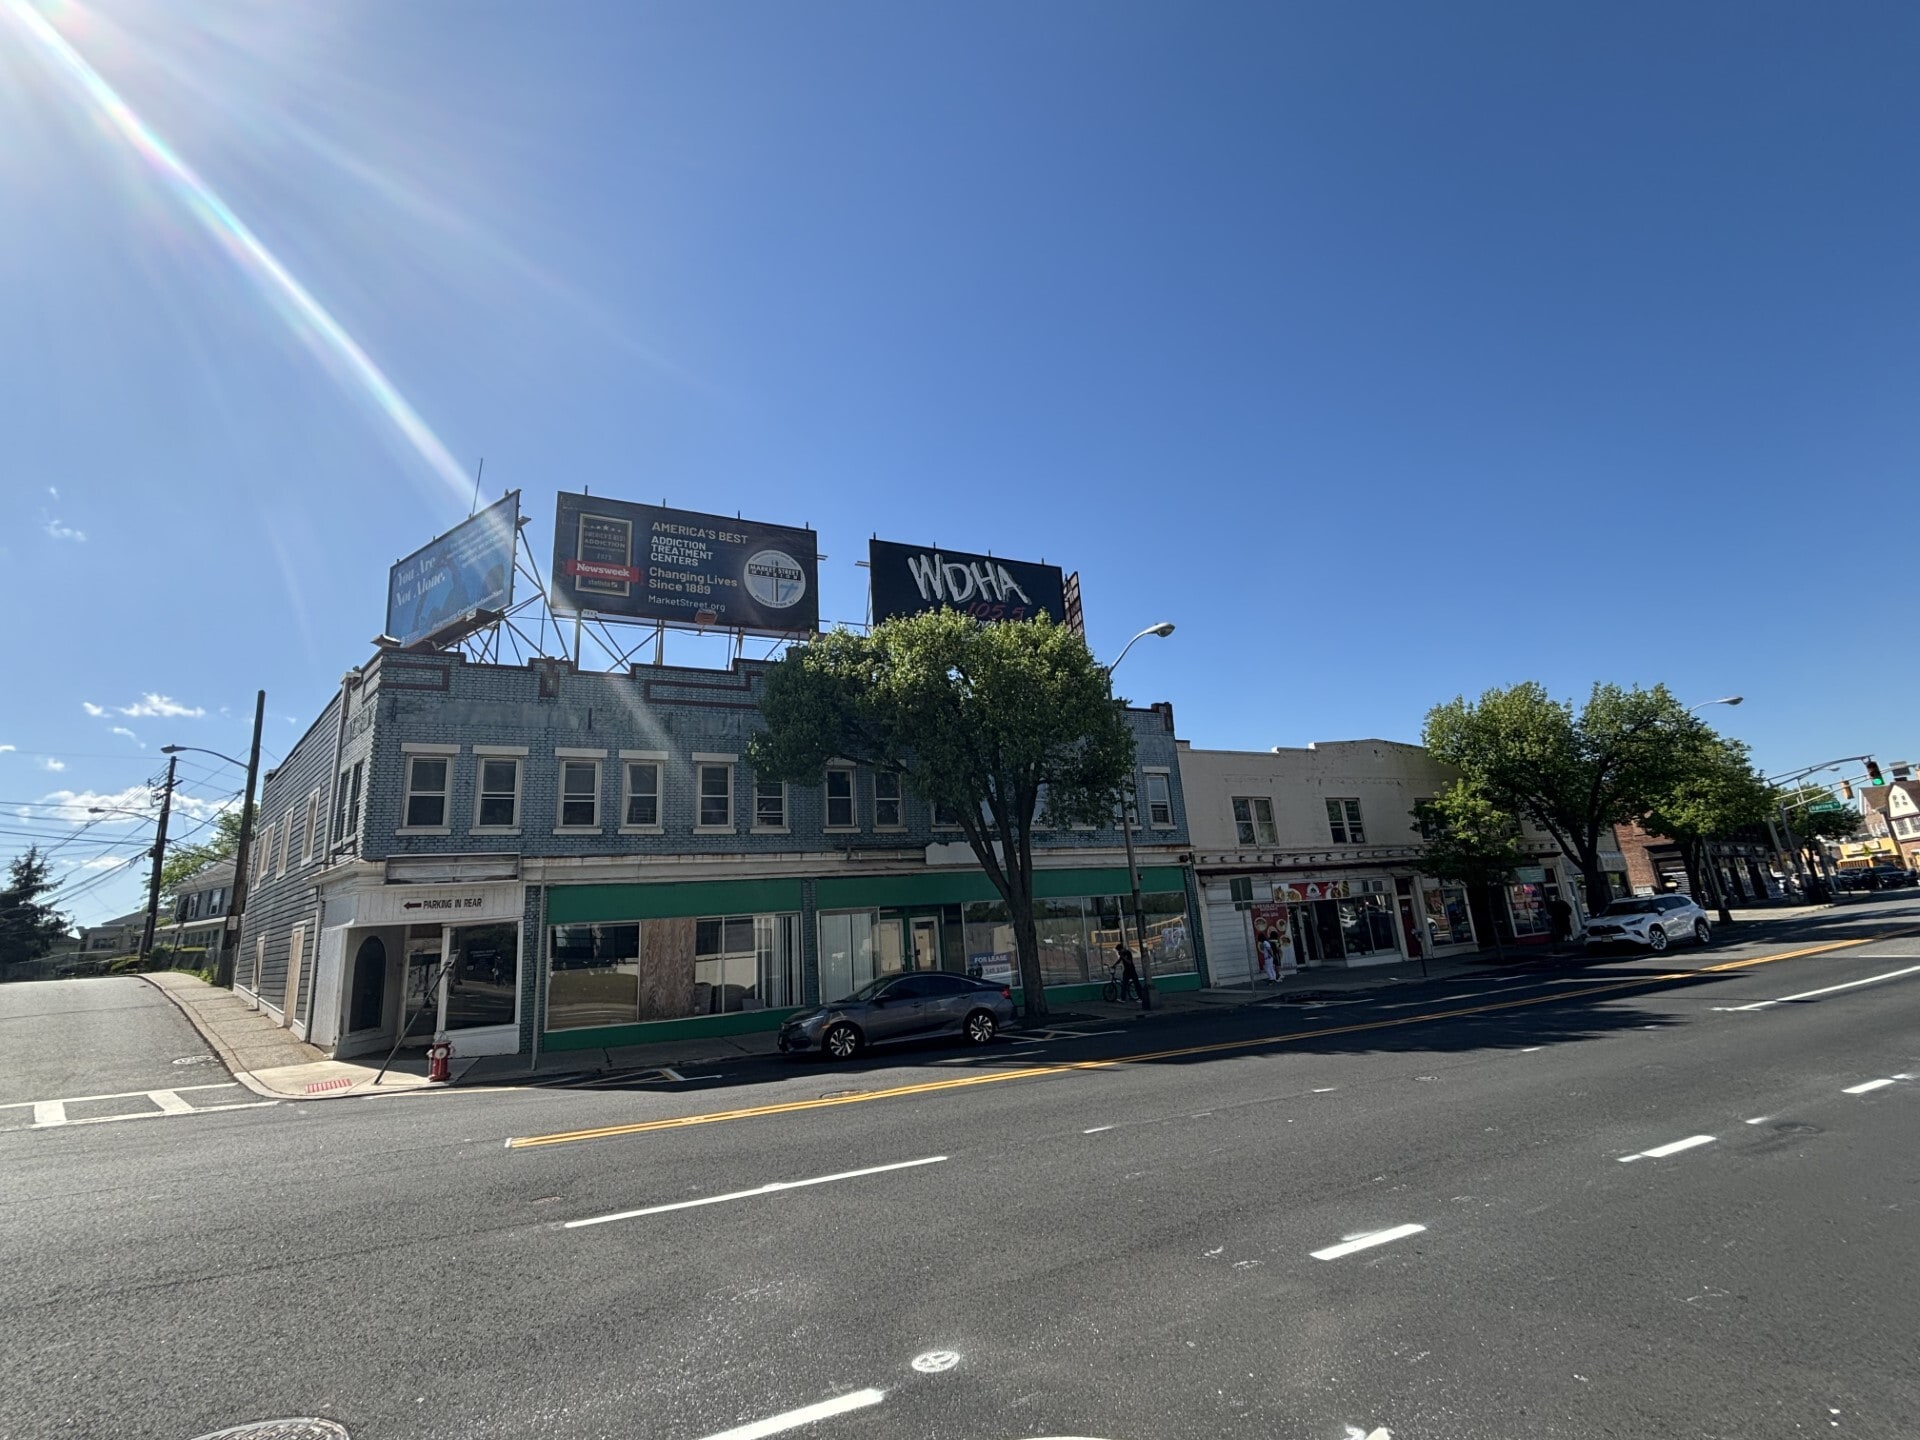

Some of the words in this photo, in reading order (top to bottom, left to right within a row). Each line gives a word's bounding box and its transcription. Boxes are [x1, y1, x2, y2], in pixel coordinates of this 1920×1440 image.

[652, 522, 716, 540] AMERICA'S
[718, 532, 748, 544] BEST
[584, 538, 626, 548] ADDICTION
[651, 535, 706, 551] ADDICTION
[650, 552, 699, 567] CENTERS
[651, 544, 714, 560] TREATMENT
[397, 569, 415, 587] You
[416, 556, 436, 577] Are
[576, 563, 630, 577] Newsweek
[649, 566, 705, 584] Changing
[707, 574, 738, 587] Lives
[750, 564, 776, 573] MARKET
[778, 568, 800, 577] STREET
[648, 579, 683, 591] Since
[685, 583, 711, 595] 1889
[907, 553, 1032, 605] WDHA
[394, 587, 411, 608] Not
[413, 571, 446, 598] Alone.
[648, 595, 726, 613] MarketStreet.org
[423, 899, 452, 909] PARKING
[454, 899, 462, 908] IN
[463, 898, 482, 908] REAR
